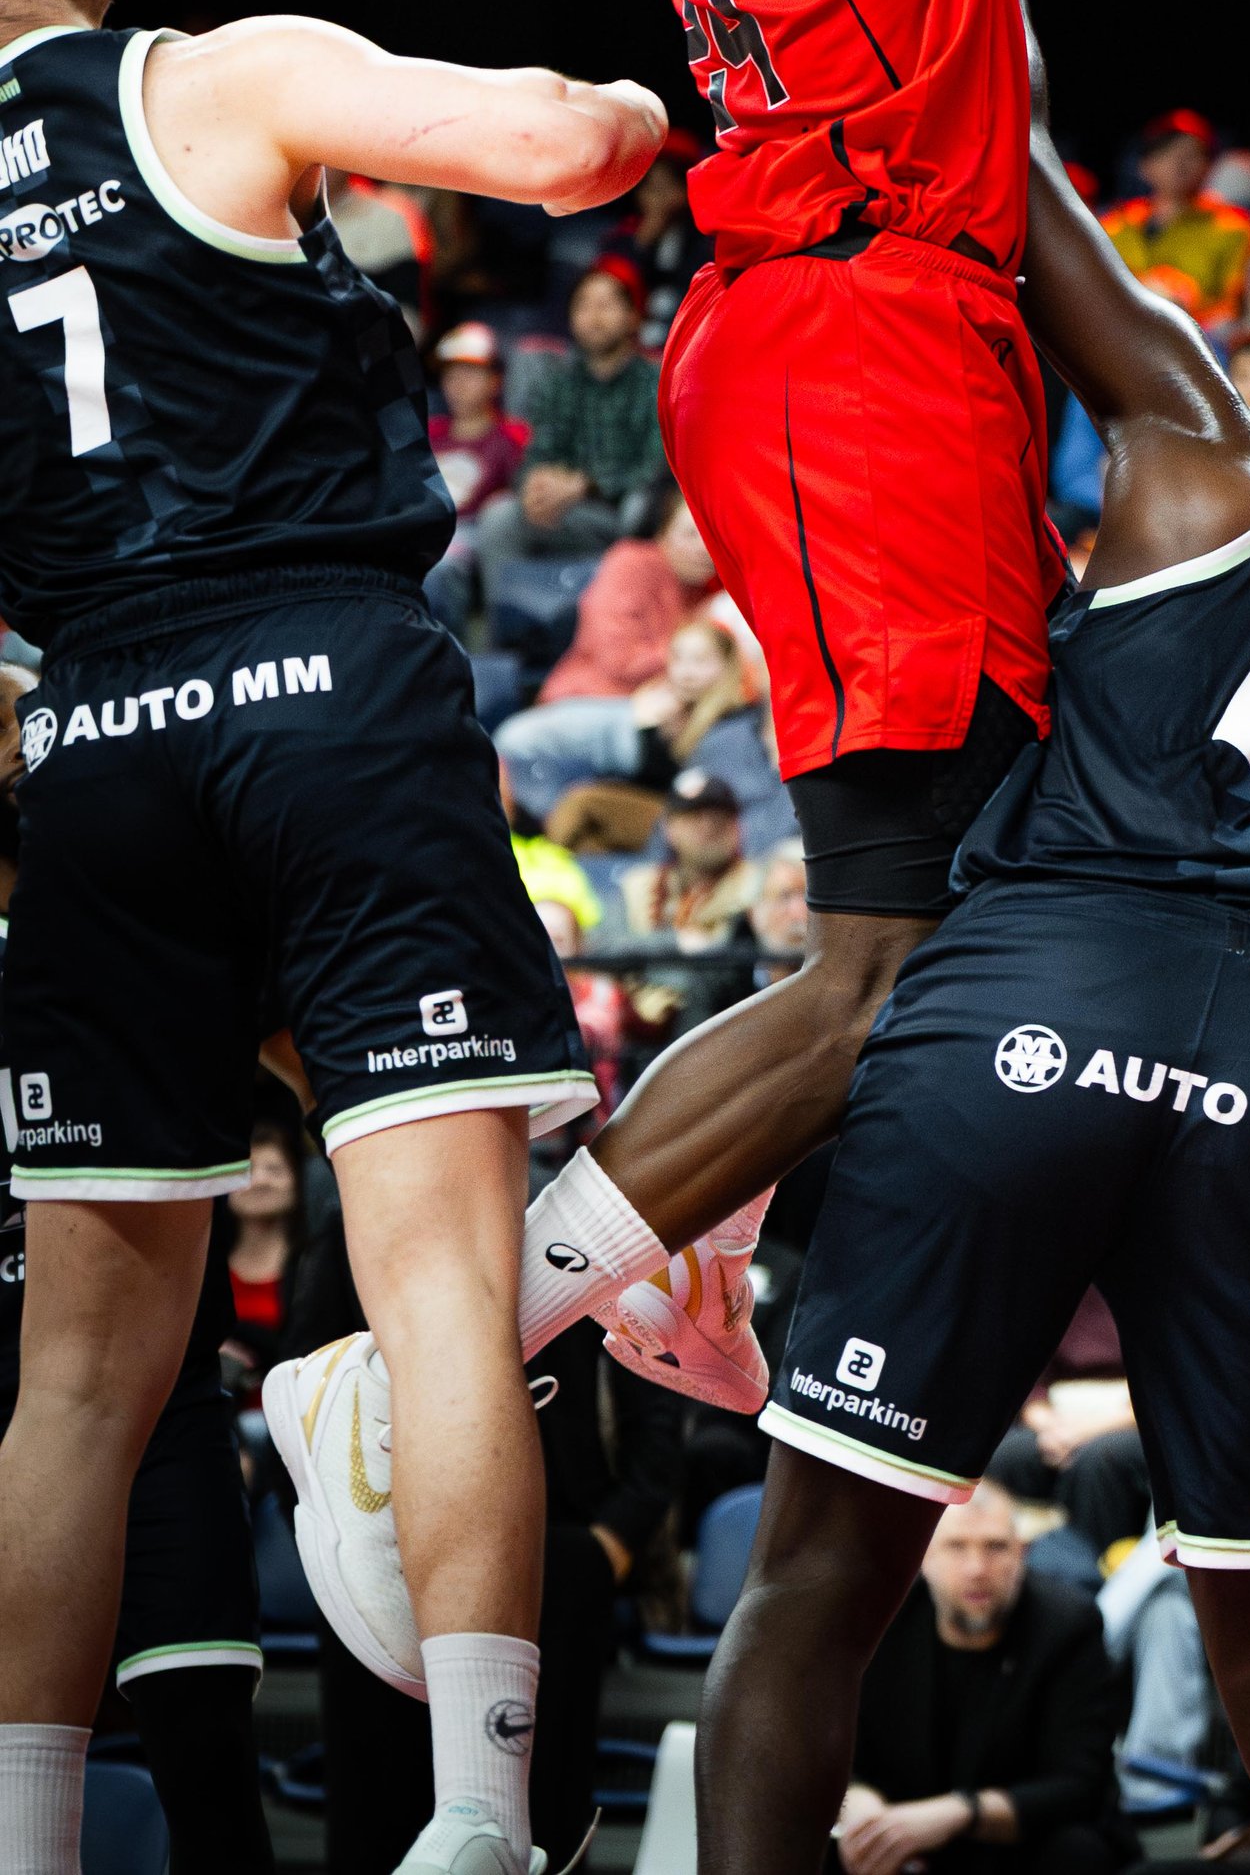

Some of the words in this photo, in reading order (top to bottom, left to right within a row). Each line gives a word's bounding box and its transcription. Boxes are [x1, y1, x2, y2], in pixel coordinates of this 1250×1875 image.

[0, 179, 126, 263] PROTEC
[8, 265, 112, 457] 7
[62, 679, 214, 746] AUTO
[232, 655, 332, 706] MM
[367, 1036, 517, 1073] Interparking
[1075, 1049, 1248, 1125] AUTO
[18, 1120, 102, 1151] rparking
[791, 1367, 927, 1441] Interparking
